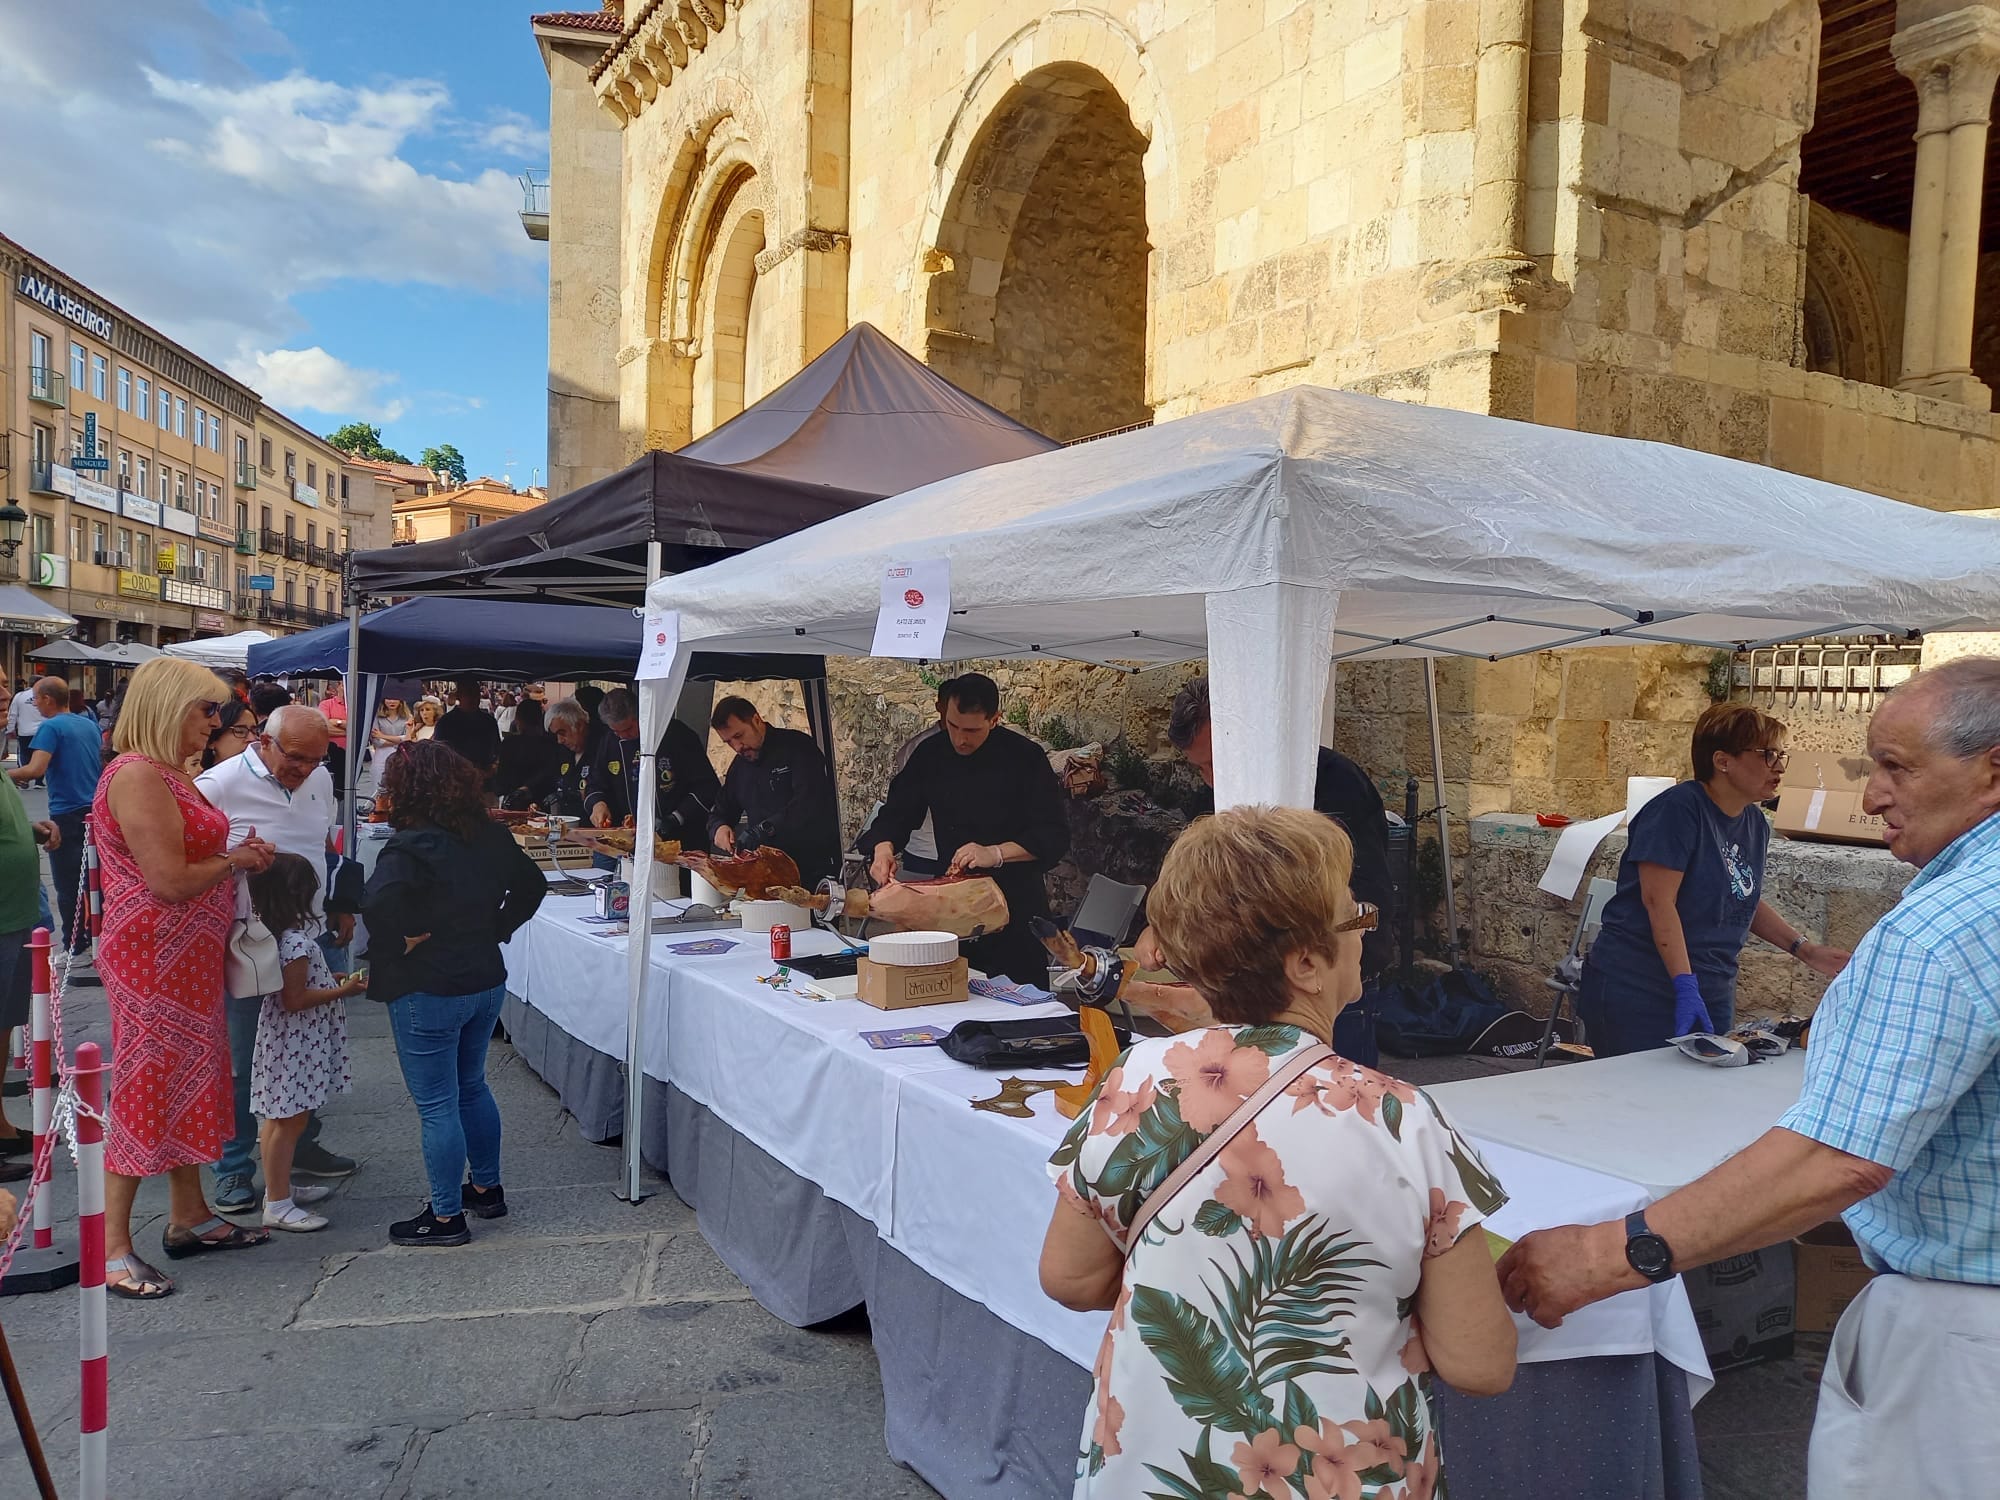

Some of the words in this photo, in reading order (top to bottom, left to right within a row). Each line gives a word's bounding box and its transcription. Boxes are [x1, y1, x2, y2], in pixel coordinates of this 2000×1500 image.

[24, 276, 56, 310] AXA
[58, 294, 111, 341] SEGUROS
[86, 414, 95, 457] OFICINAS
[157, 560, 174, 569] ORO
[131, 574, 151, 591] ORO
